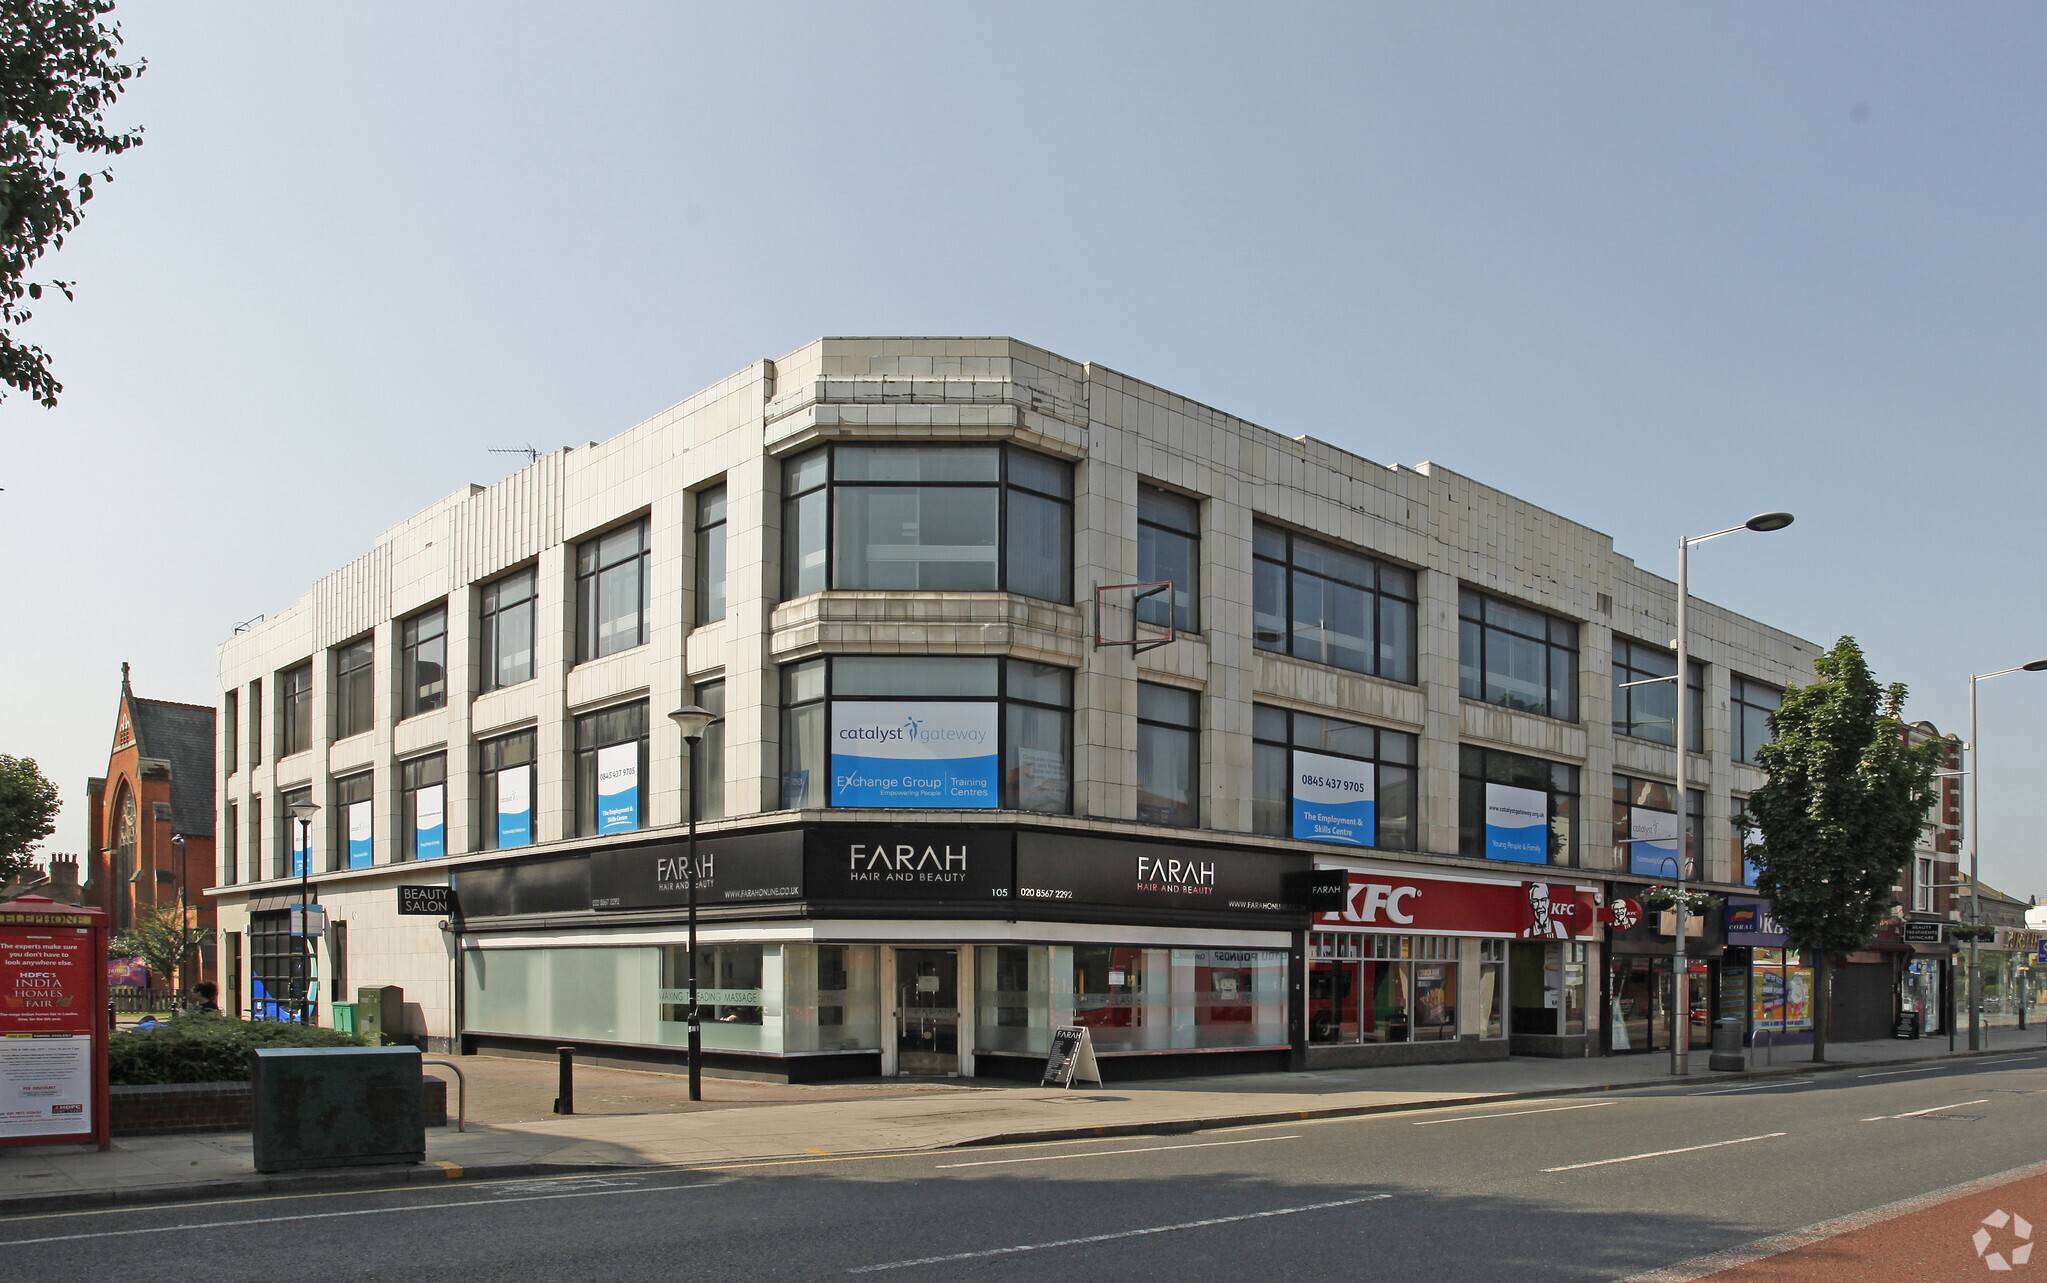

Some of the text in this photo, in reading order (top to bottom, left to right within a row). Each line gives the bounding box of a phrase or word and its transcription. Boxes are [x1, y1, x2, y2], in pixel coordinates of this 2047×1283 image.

[839, 726, 987, 744] catalyst gateway
[600, 767, 636, 780] 0845 437 9705
[902, 776, 942, 791] Group
[950, 777, 987, 788] Training
[1301, 774, 1364, 792] 0845 437 9705
[950, 788, 988, 797] Centres
[1303, 811, 1316, 820] The
[1317, 813, 1357, 826] Employment
[1314, 824, 1353, 836] Skills Centre
[1492, 840, 1507, 849] Young
[1507, 842, 1522, 850] People
[1527, 843, 1541, 853] Family
[850, 844, 966, 871] FARAH
[1137, 856, 1215, 885] FARAH
[850, 872, 966, 882] HAIR AND BEAUTY
[658, 883, 674, 891] HAIR
[675, 881, 690, 890] AND
[1136, 882, 1213, 895] HAIR AND BEAUTY
[1312, 885, 1341, 894] FARAH
[404, 888, 448, 900] BEAUTY
[724, 887, 799, 898] WWW.FARAHONLINE.CO.UK
[991, 888, 1008, 897] 105
[1020, 887, 1073, 899] 020 8567 2292
[405, 900, 448, 912] SALON
[1550, 902, 1575, 915] KFC
[2, 914, 85, 924] ELEPHONE
[15, 979, 62, 988] INDIA
[15, 989, 63, 998] HOMES
[685, 992, 722, 1002] TEADING
[724, 992, 757, 1003] MASSAGE
[25, 1000, 53, 1008] FAIR
[1056, 1030, 1082, 1039] FARAH
